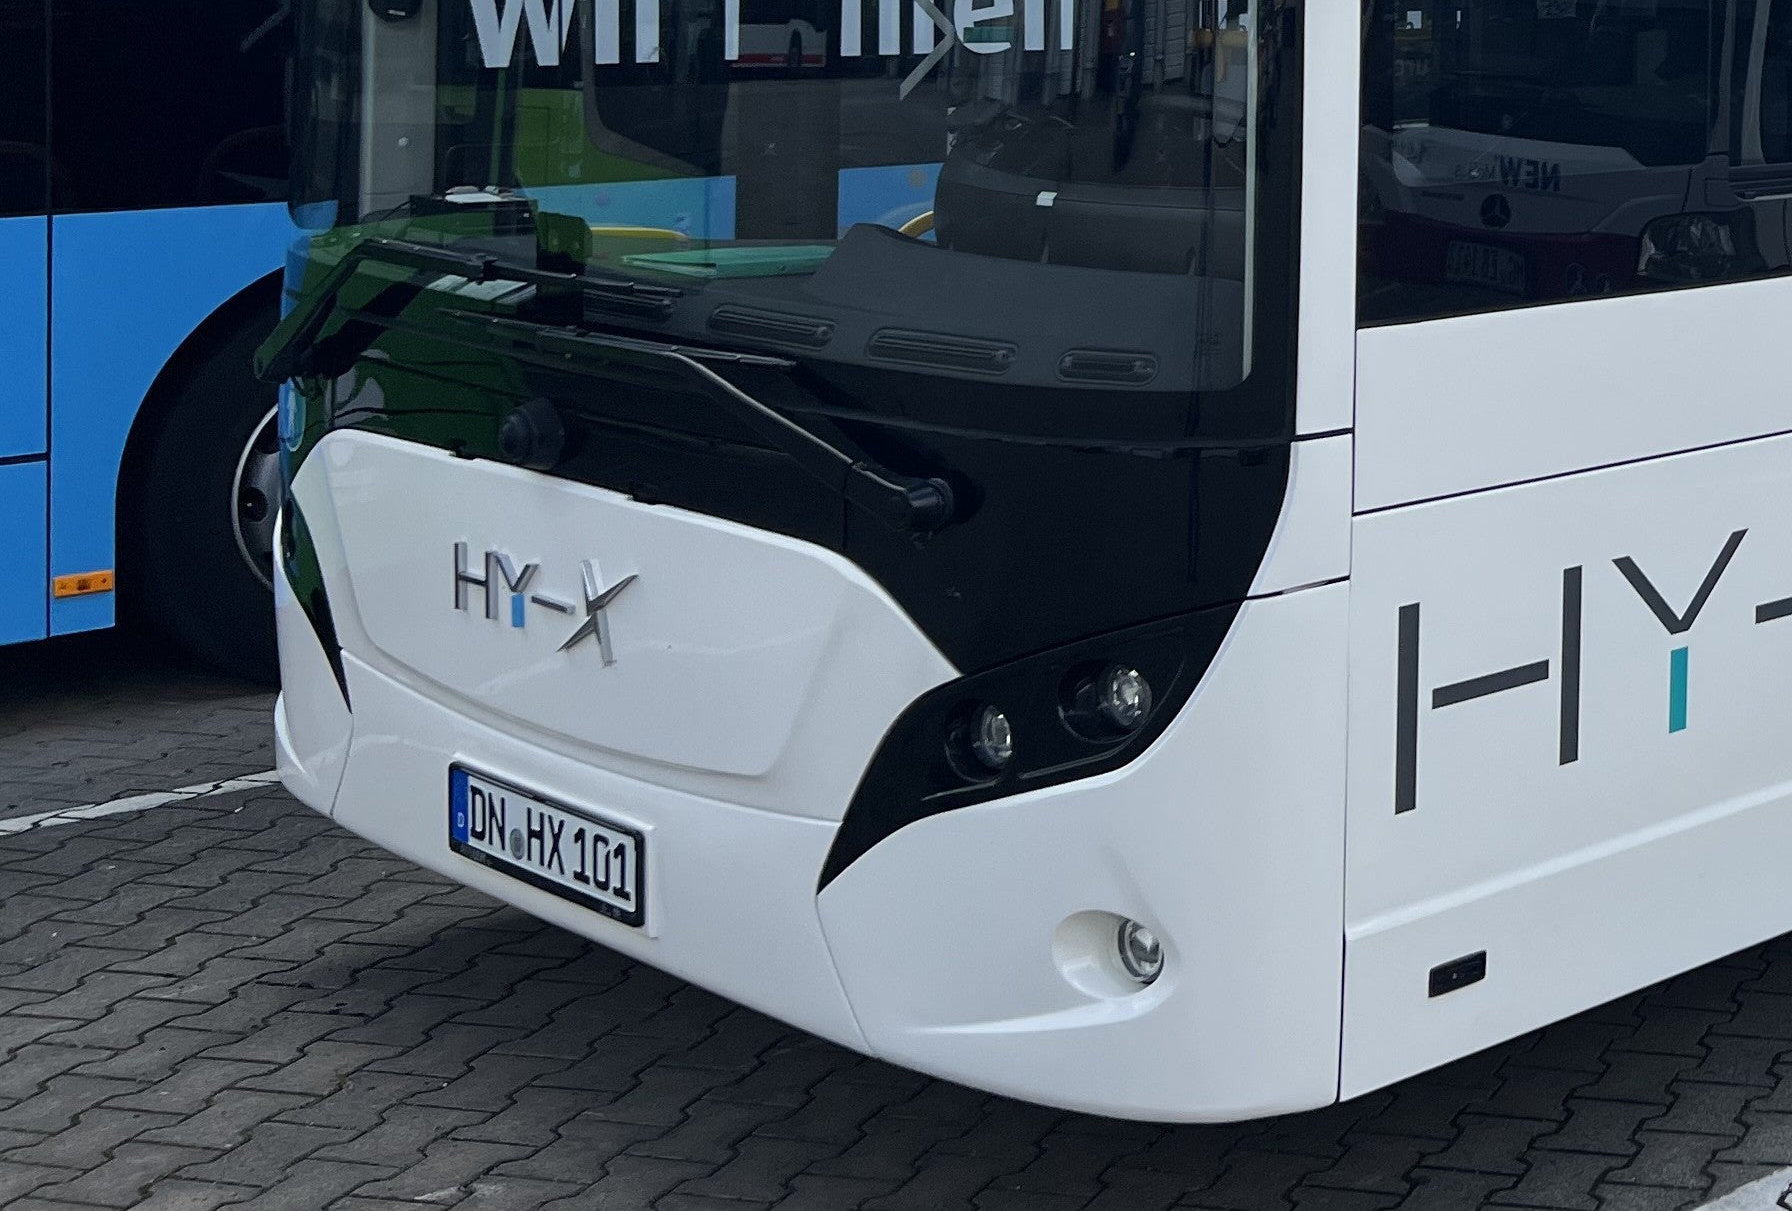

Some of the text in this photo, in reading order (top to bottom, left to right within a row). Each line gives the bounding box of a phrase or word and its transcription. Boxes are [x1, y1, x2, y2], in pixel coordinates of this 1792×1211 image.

[453, 541, 640, 666] HY-X
[469, 784, 506, 851] DN
[526, 806, 565, 876] HX
[572, 826, 632, 902] 101
